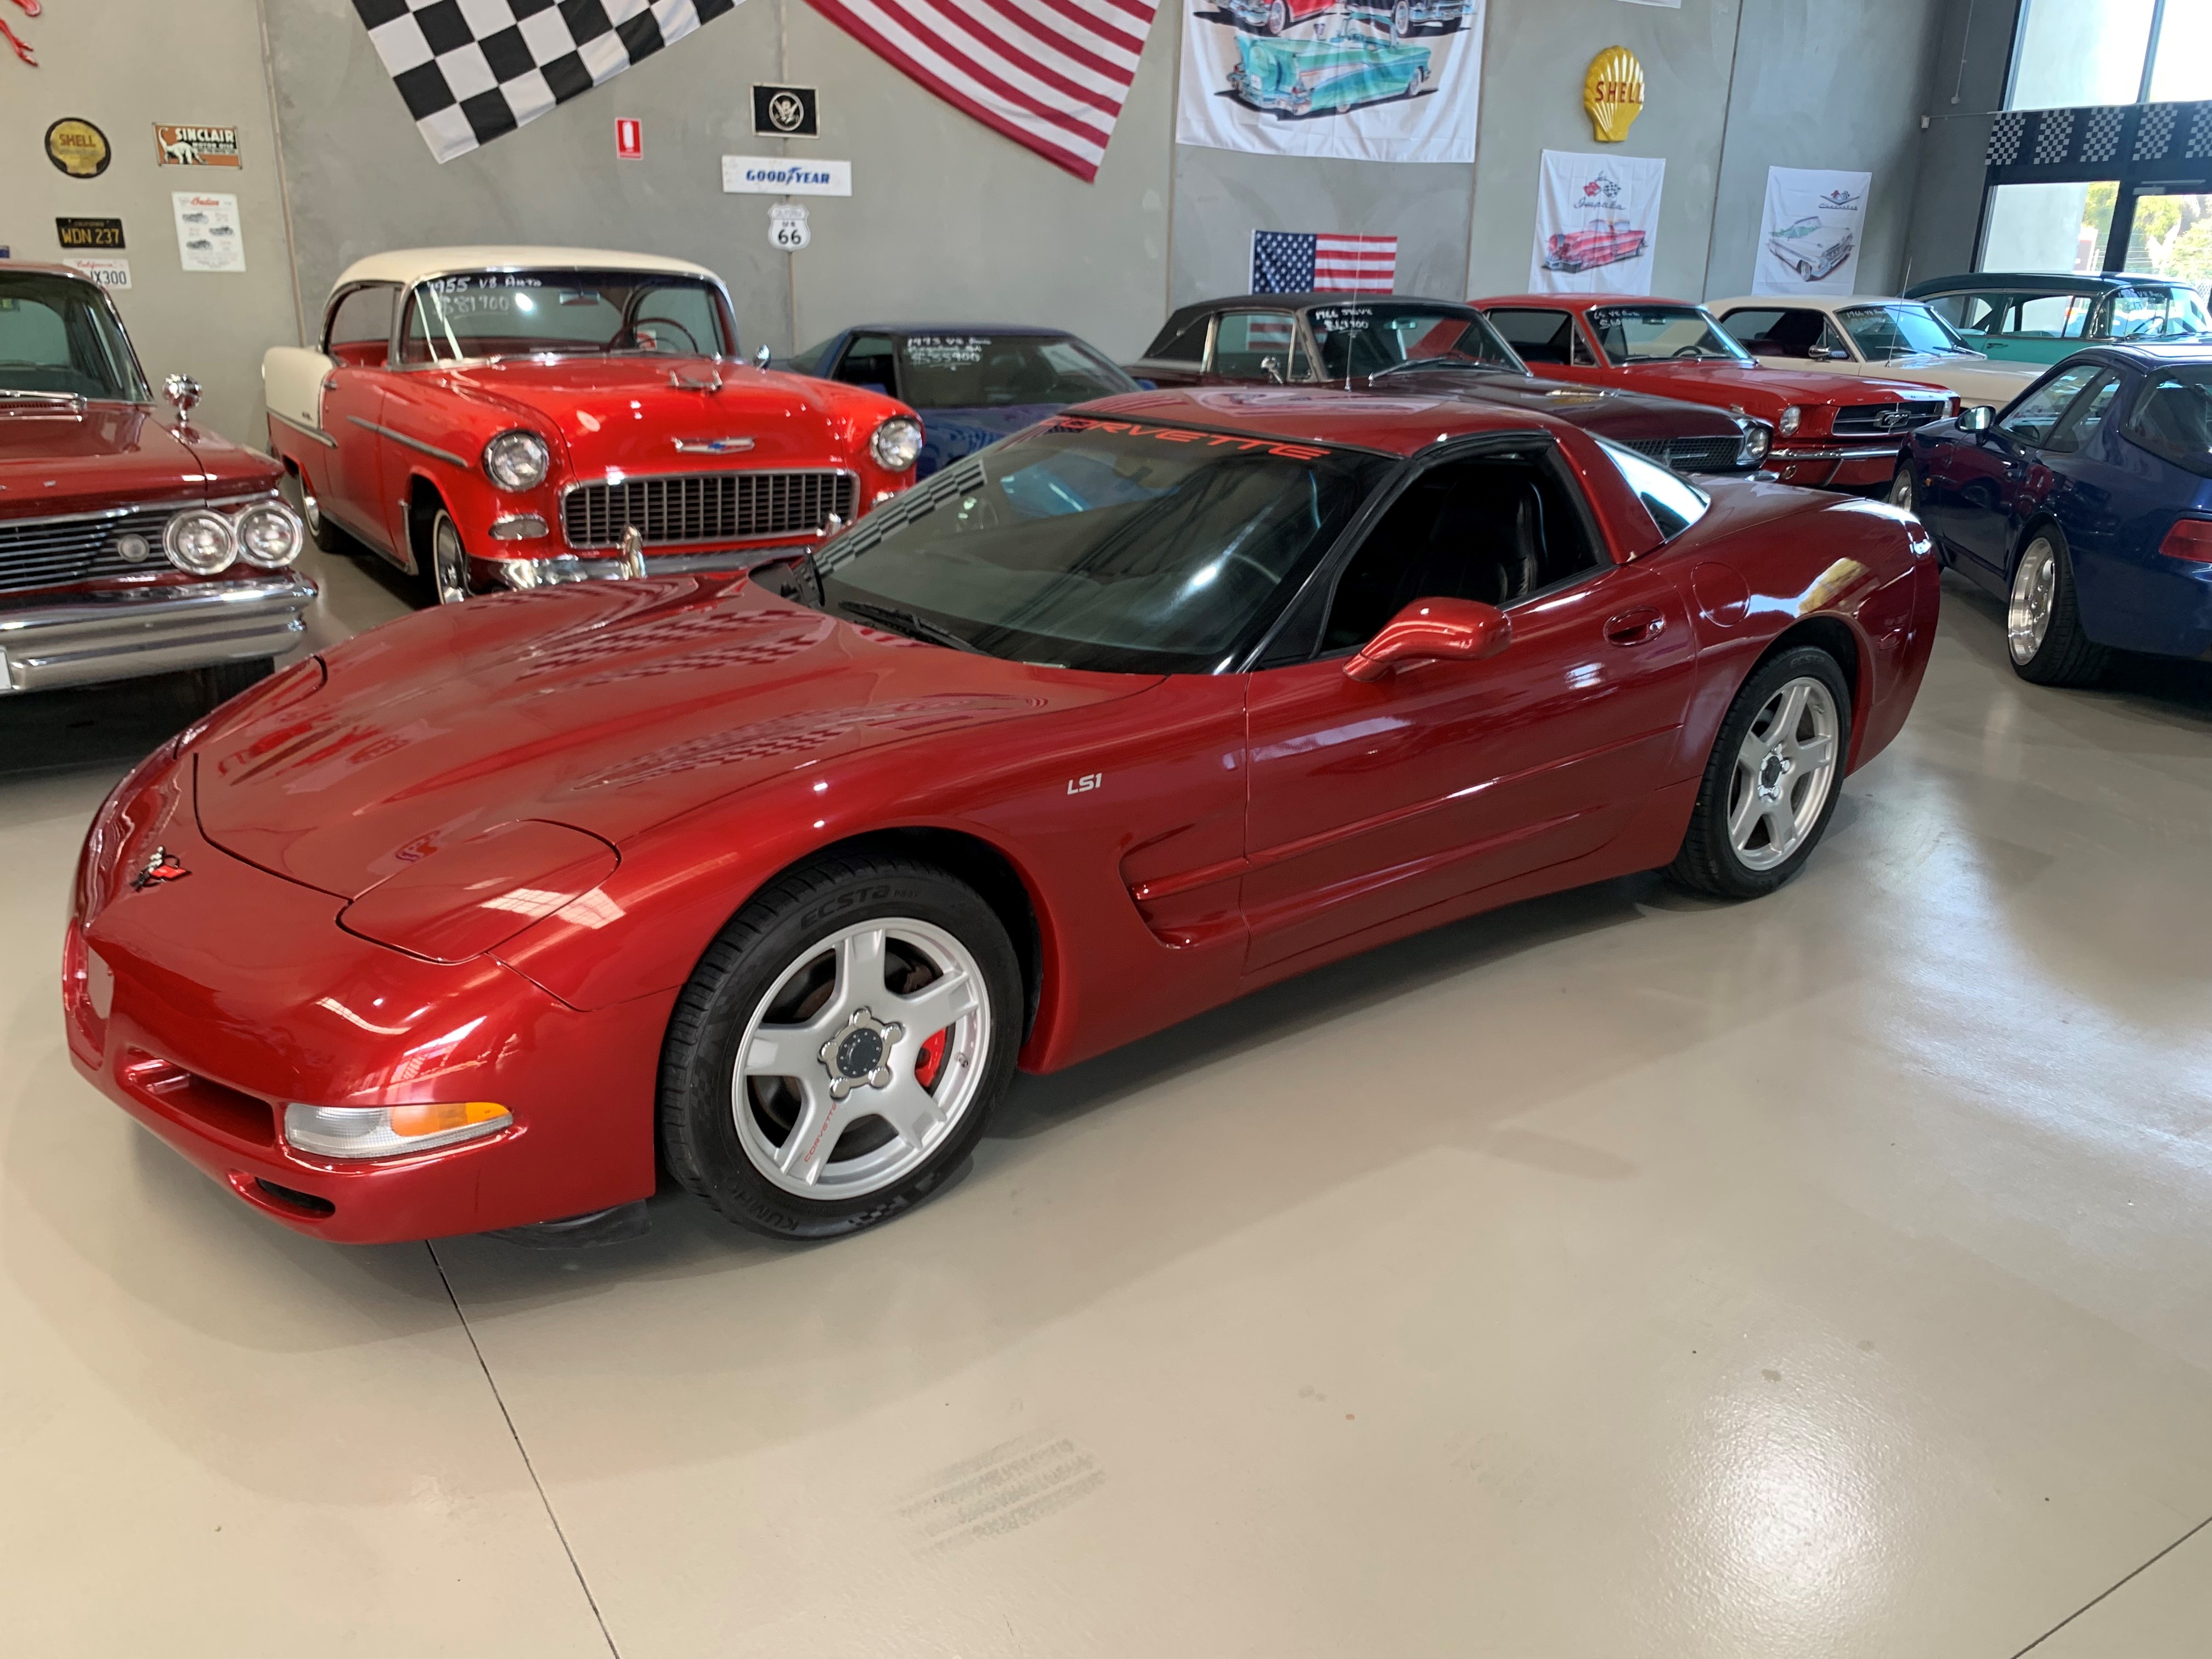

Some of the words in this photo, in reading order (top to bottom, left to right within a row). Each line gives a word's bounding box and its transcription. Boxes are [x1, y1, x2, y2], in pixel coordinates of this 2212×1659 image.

[1595, 81, 1643, 104] SHELL
[59, 134, 96, 147] SHELL
[175, 127, 235, 143] SINCLAIR
[746, 168, 831, 184] GOODYEAR
[1573, 196, 1627, 210] Impala
[61, 228, 92, 244] WDN
[94, 228, 120, 245] 237
[778, 229, 802, 245] 66
[427, 276, 471, 295] 1955
[479, 274, 497, 289] V8
[1039, 416, 1330, 460] CORVETTE
[1067, 772, 1102, 795] LS1
